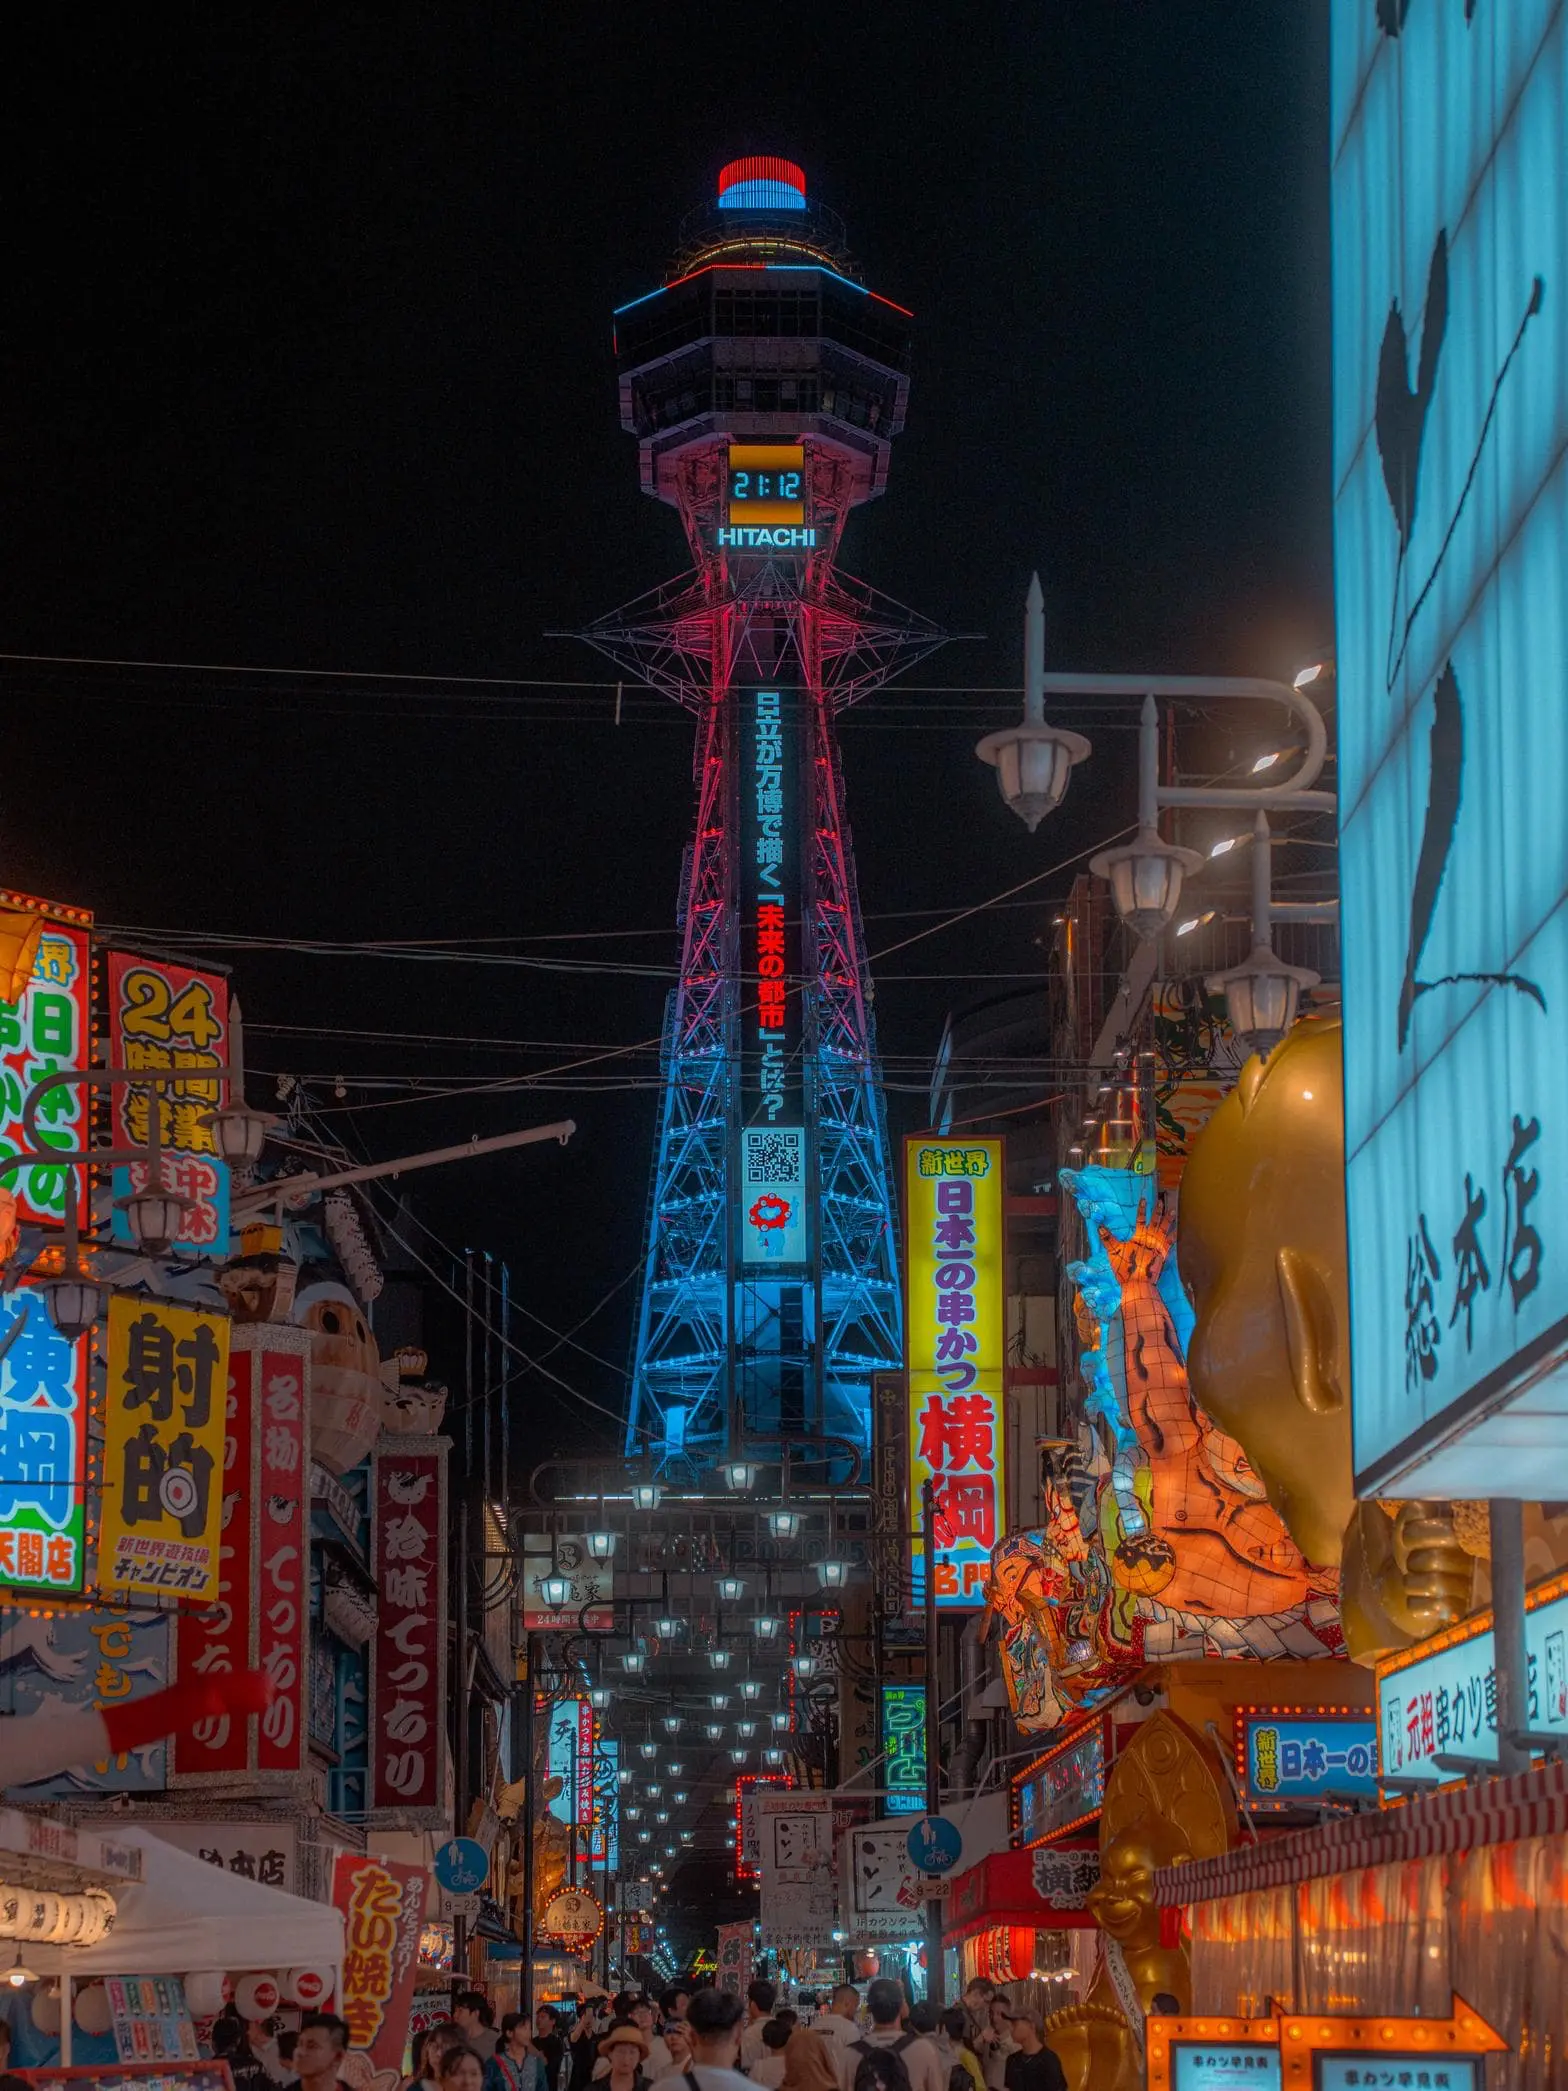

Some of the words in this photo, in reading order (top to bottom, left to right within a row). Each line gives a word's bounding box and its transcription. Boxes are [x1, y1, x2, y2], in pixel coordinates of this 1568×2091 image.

[734, 472, 799, 499] 21:12
[718, 527, 816, 547] HITACHI
[33, 939, 74, 985] 界
[122, 970, 221, 1049] 24
[125, 1038, 221, 1103] 時間
[127, 1091, 218, 1155] 営業
[919, 1149, 991, 1177] 新世界
[934, 1181, 978, 1389] 日本一の串かつ
[1404, 1114, 1543, 1395] 総本店
[122, 1312, 220, 1538] 射的
[265, 1374, 299, 1474] 名物
[919, 1395, 995, 1549] 横綱
[114, 1558, 210, 1591] チャンピオン
[116, 1536, 210, 1564] 新世界遊技場
[1255, 1729, 1280, 1792] 新世界
[342, 1870, 401, 2043] たい焼き
